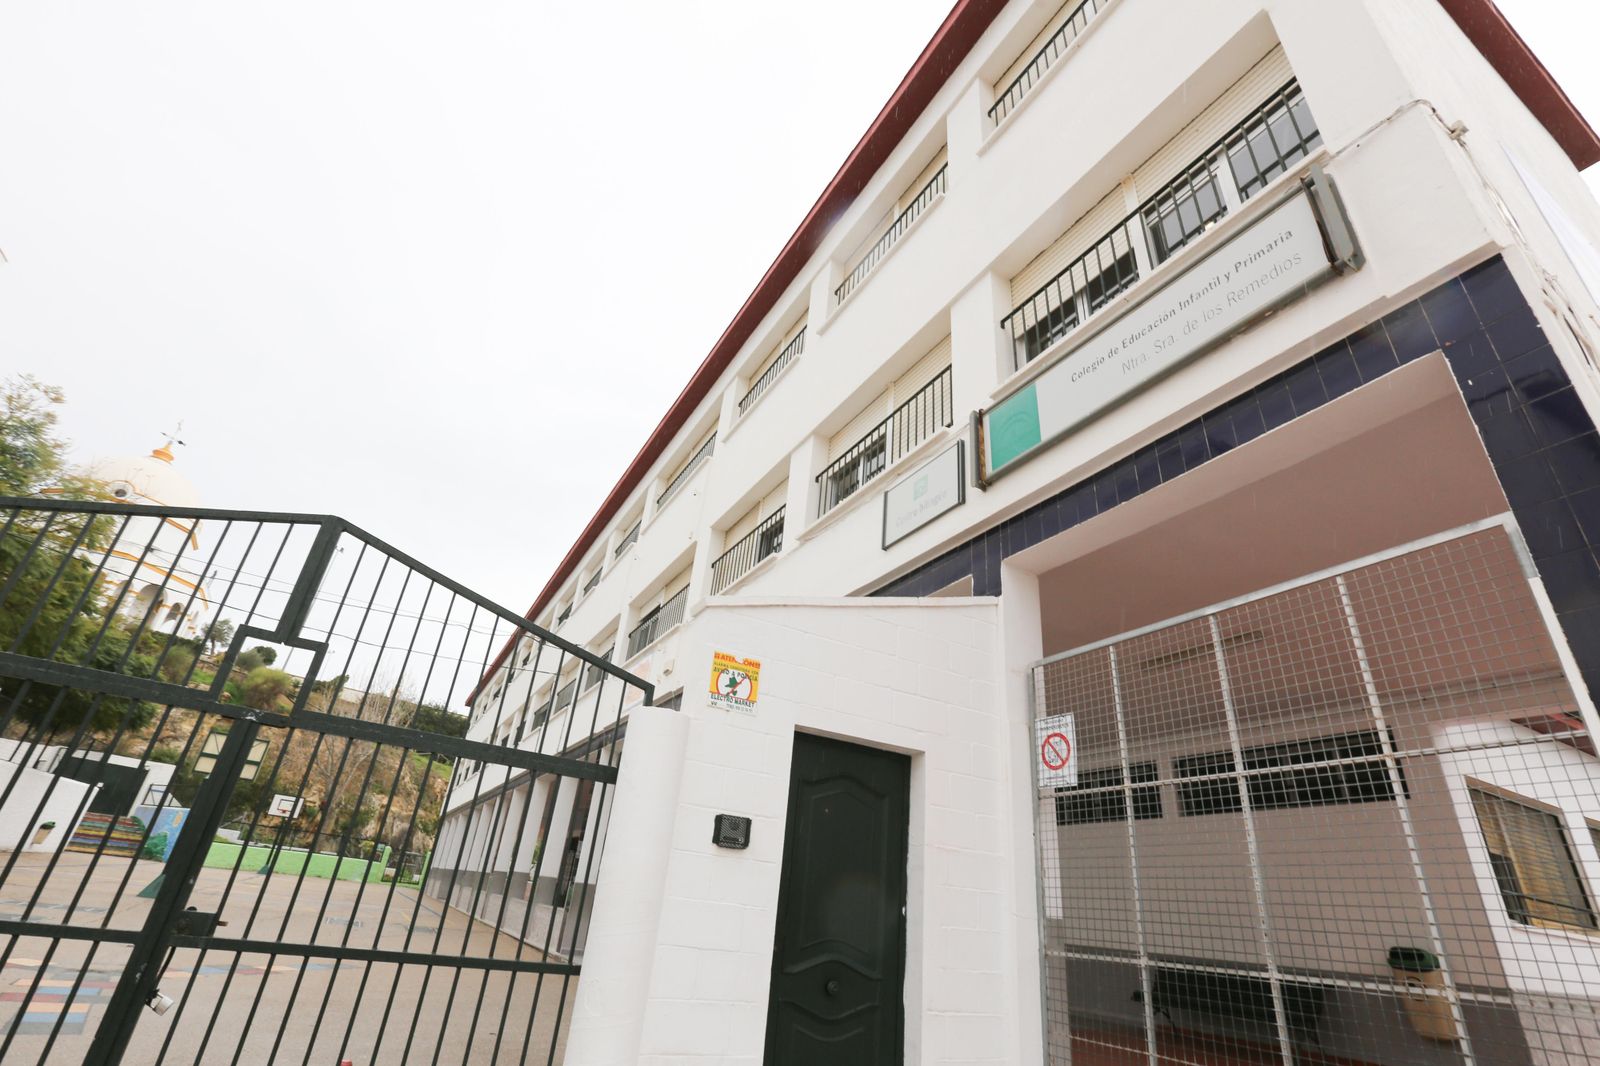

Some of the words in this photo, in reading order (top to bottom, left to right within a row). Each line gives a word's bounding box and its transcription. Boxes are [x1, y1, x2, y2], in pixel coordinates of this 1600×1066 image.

[1071, 355, 1105, 384] Colegio
[1107, 346, 1119, 360] de
[1122, 308, 1176, 349] Educación
[1178, 275, 1221, 311] Infantil
[1223, 271, 1231, 283] y
[1234, 229, 1294, 274] Primaria
[1121, 351, 1151, 375] Ntra.
[1152, 335, 1179, 355] Sra.
[1183, 318, 1199, 336] de
[1203, 304, 1224, 323] los
[1226, 251, 1303, 308] Remedios
[711, 693, 733, 703] ELECTRO
[734, 698, 755, 708] MARKET
